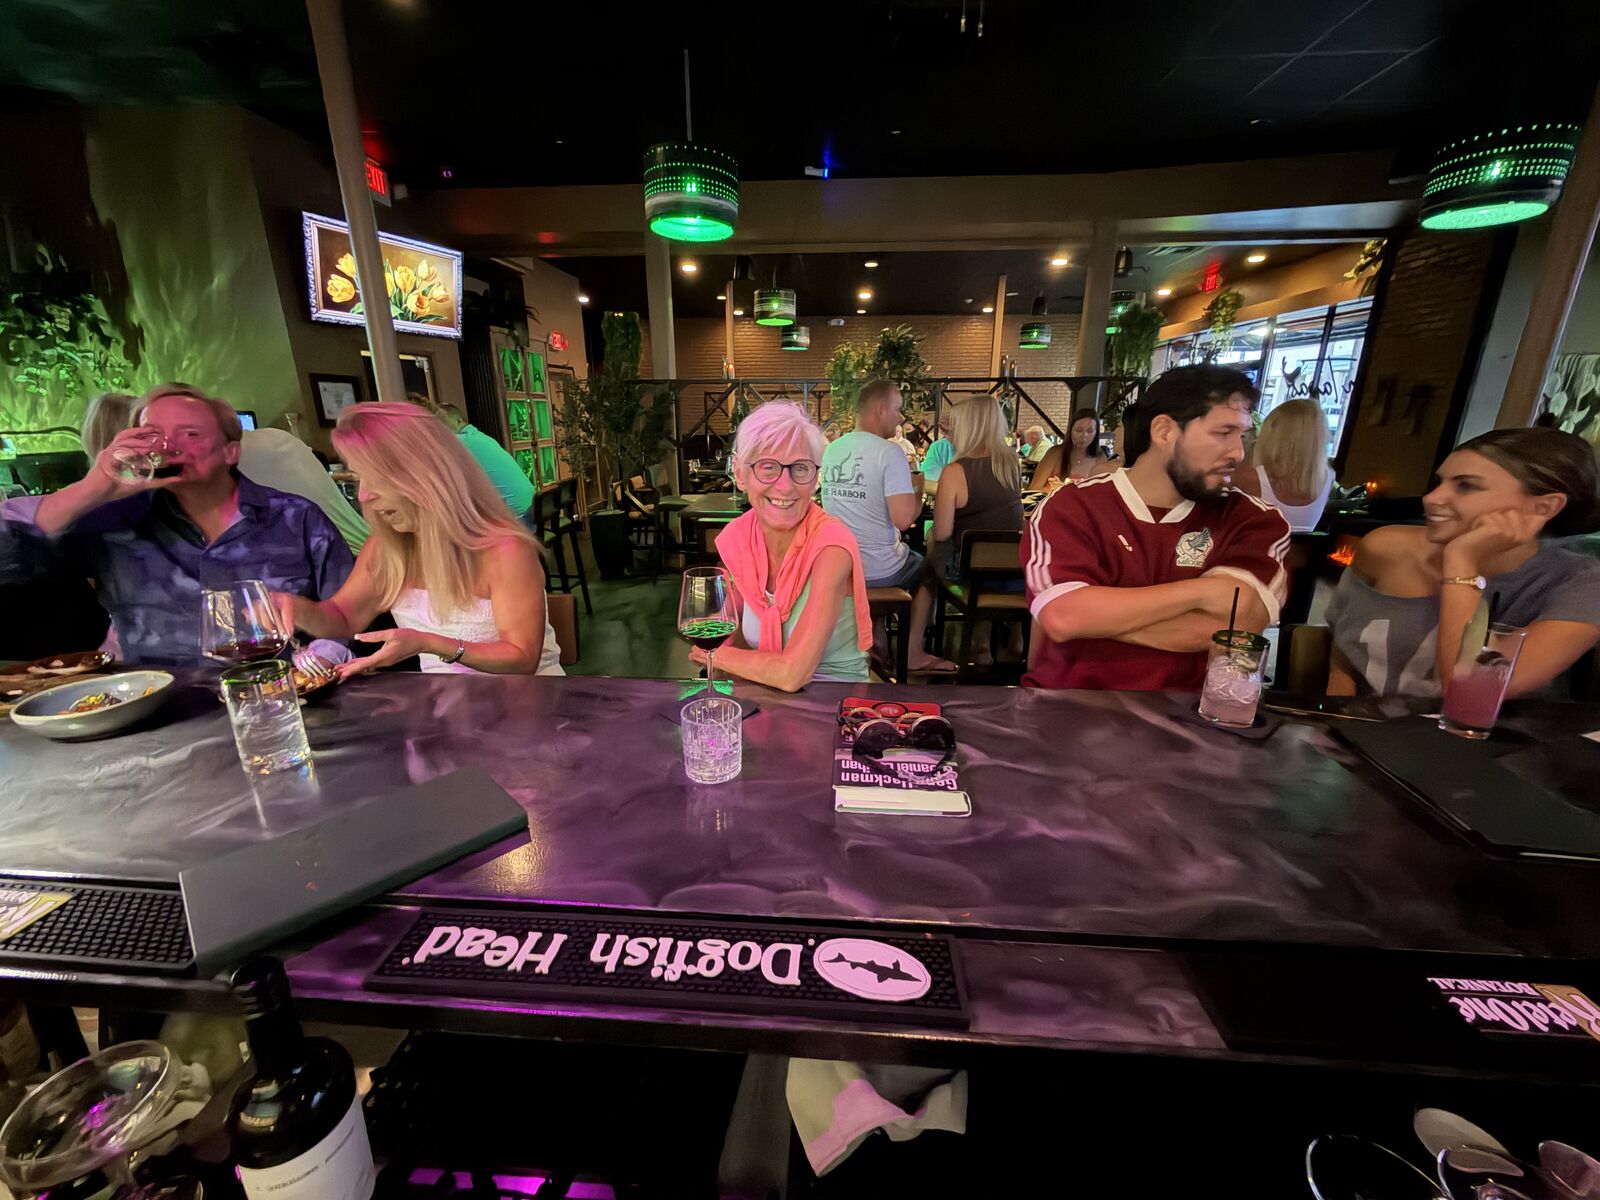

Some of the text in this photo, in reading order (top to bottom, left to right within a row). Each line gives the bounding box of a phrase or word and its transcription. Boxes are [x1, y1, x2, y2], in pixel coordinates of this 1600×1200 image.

[831, 487, 866, 499] HARBOR
[590, 933, 804, 985] Dogfish
[1426, 977, 1541, 997] BOTANICAL
